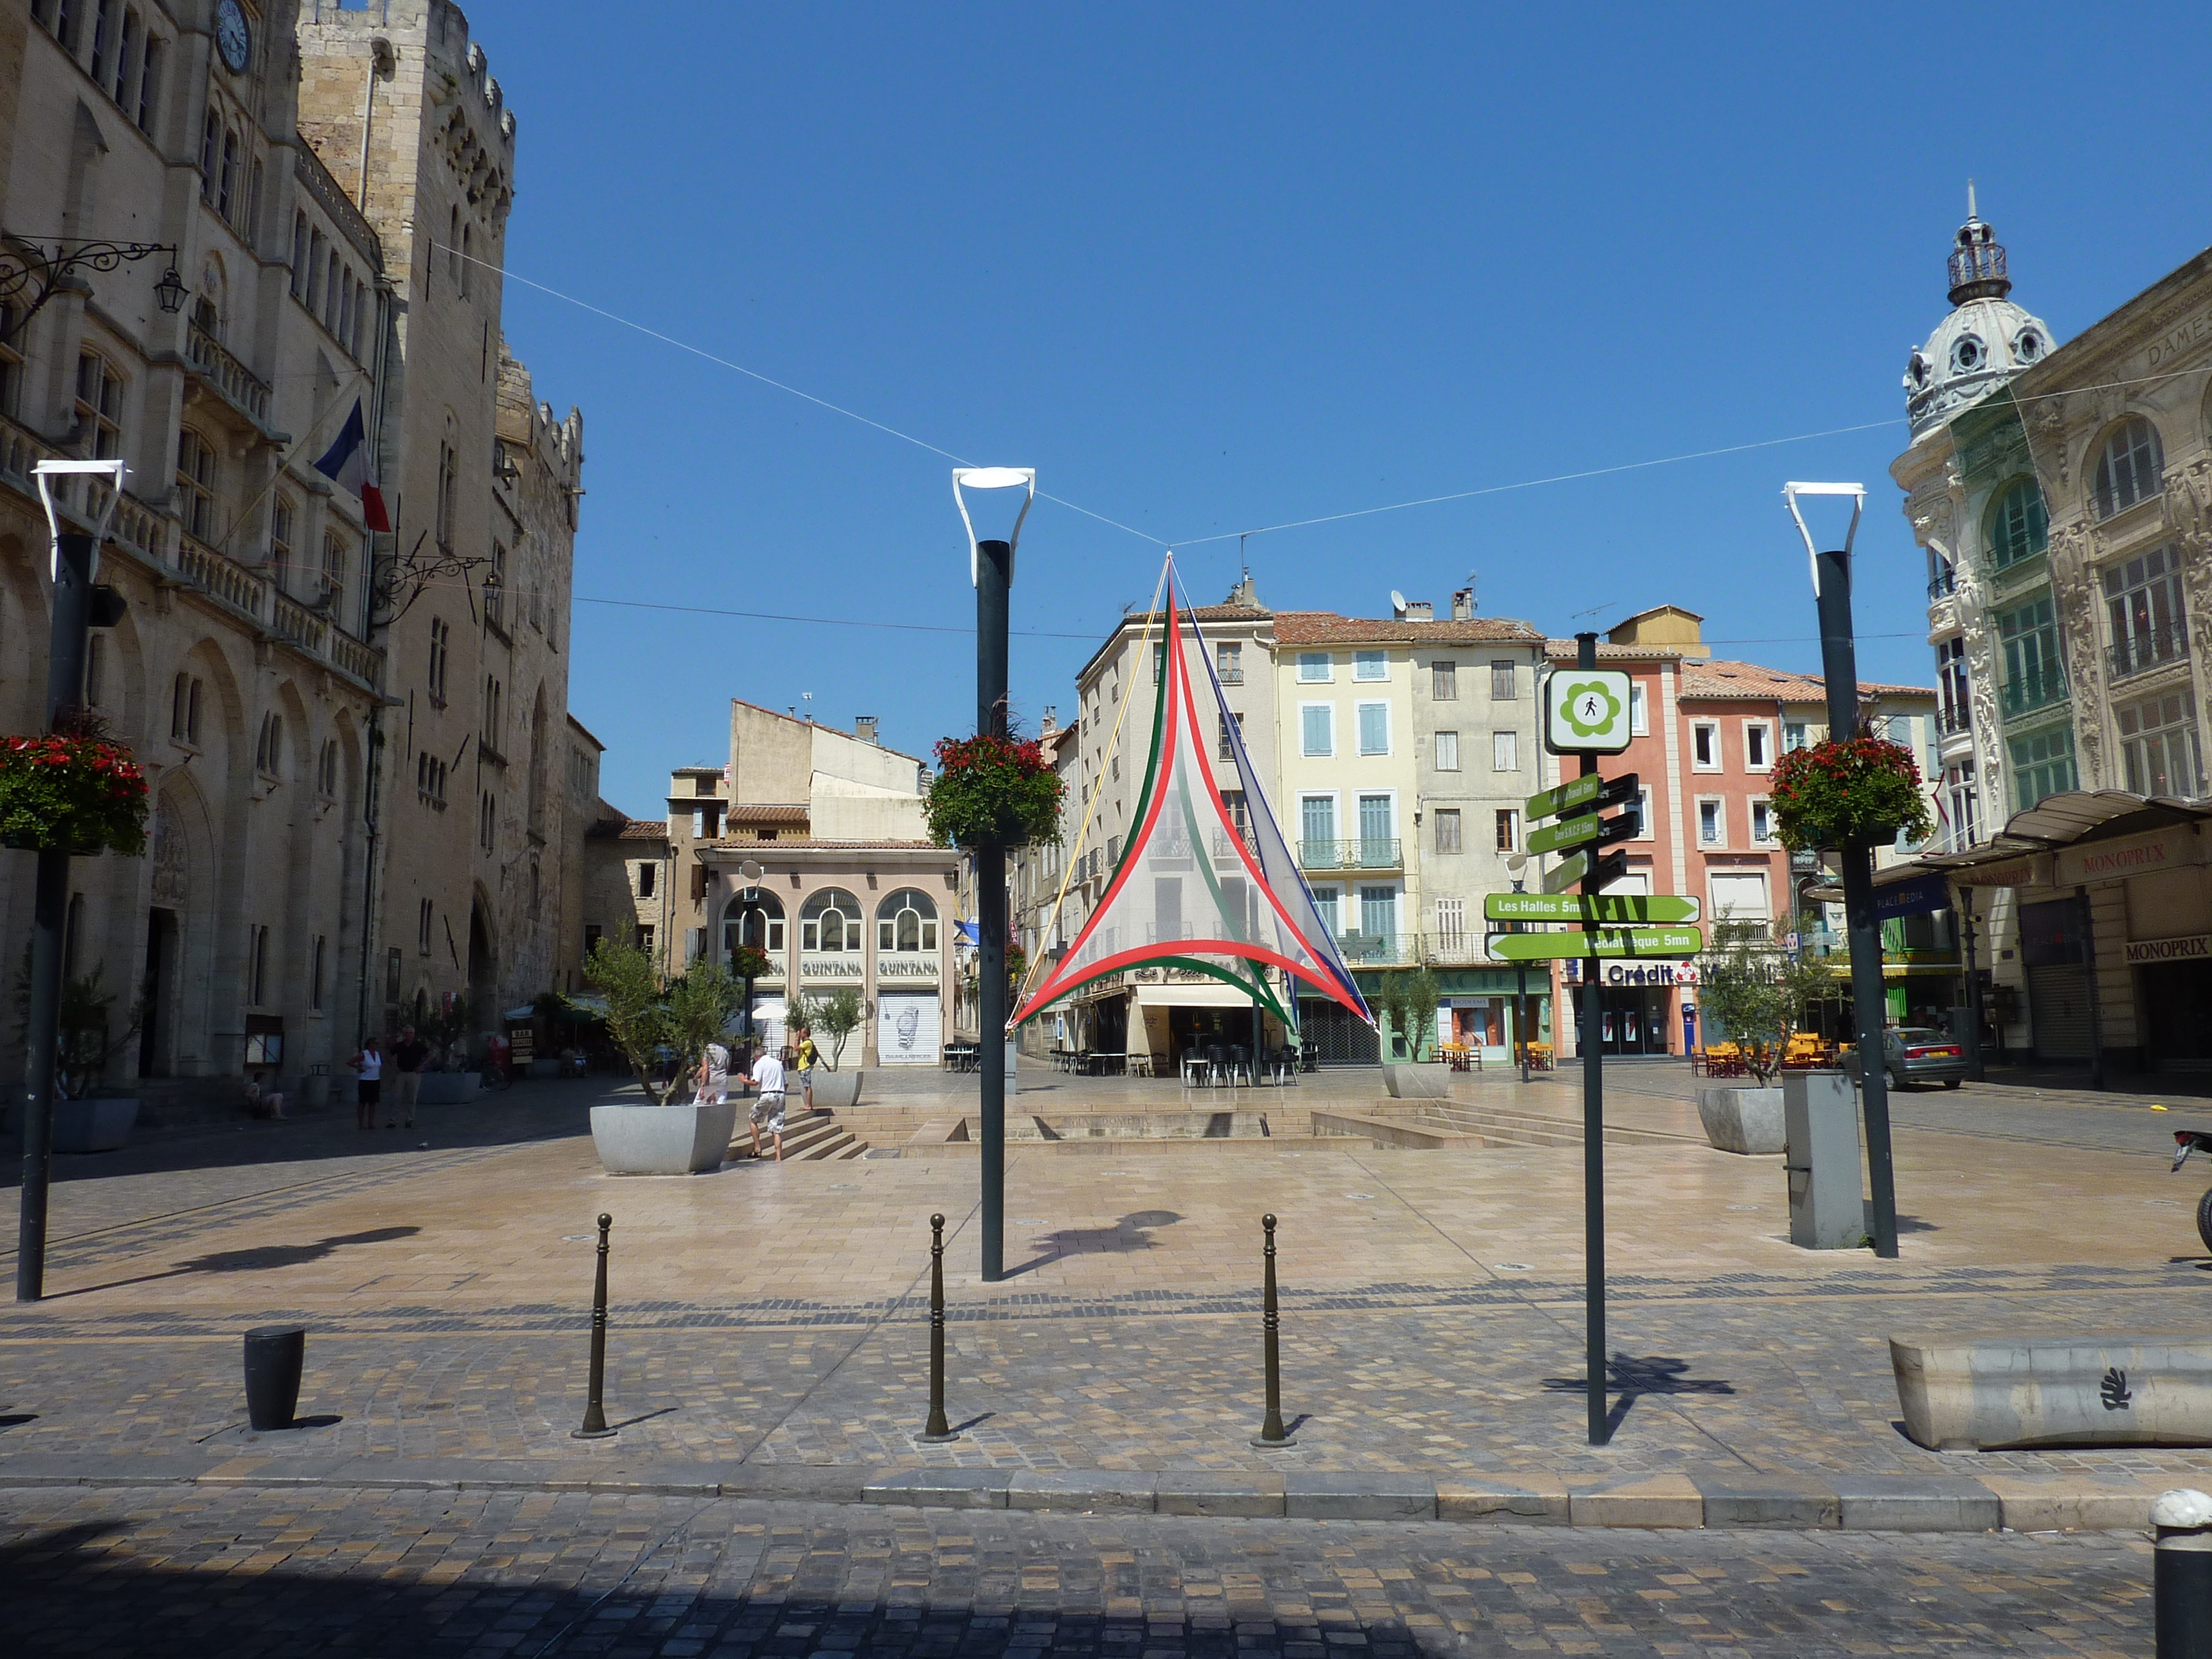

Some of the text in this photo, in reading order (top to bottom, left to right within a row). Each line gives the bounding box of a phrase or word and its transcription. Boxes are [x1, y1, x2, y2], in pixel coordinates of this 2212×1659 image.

[2084, 843, 2166, 873] MONOPRIX
[1498, 900, 1587, 913] Les Halles 5mn
[1584, 934, 1690, 949] Médiathèque 5mn
[2126, 937, 2208, 960] MONOPRIX
[802, 960, 863, 976] QUINTANA
[878, 960, 939, 976] QUINTANA
[1608, 964, 1674, 983] Crédit
